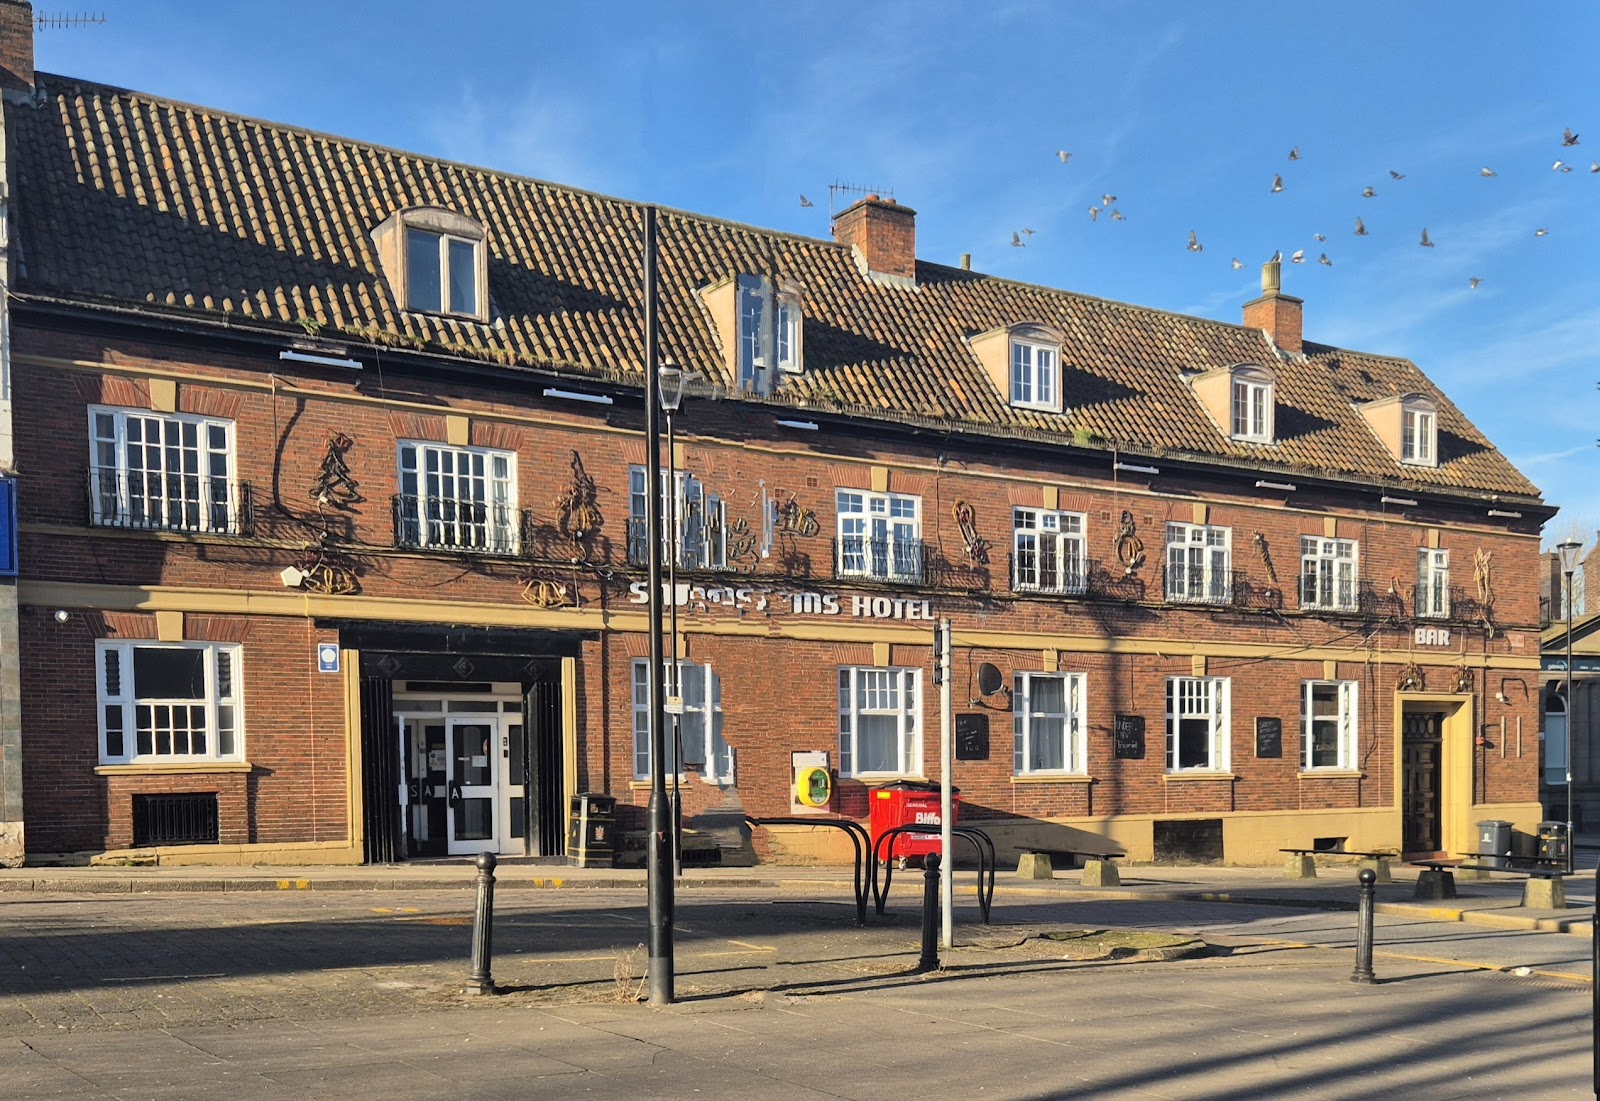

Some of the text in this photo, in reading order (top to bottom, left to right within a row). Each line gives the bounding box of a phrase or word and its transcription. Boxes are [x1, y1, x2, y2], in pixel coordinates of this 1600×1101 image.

[852, 595, 935, 621] HOTEL
[1414, 628, 1451, 646] BAR
[915, 812, 941, 825] Biffa
